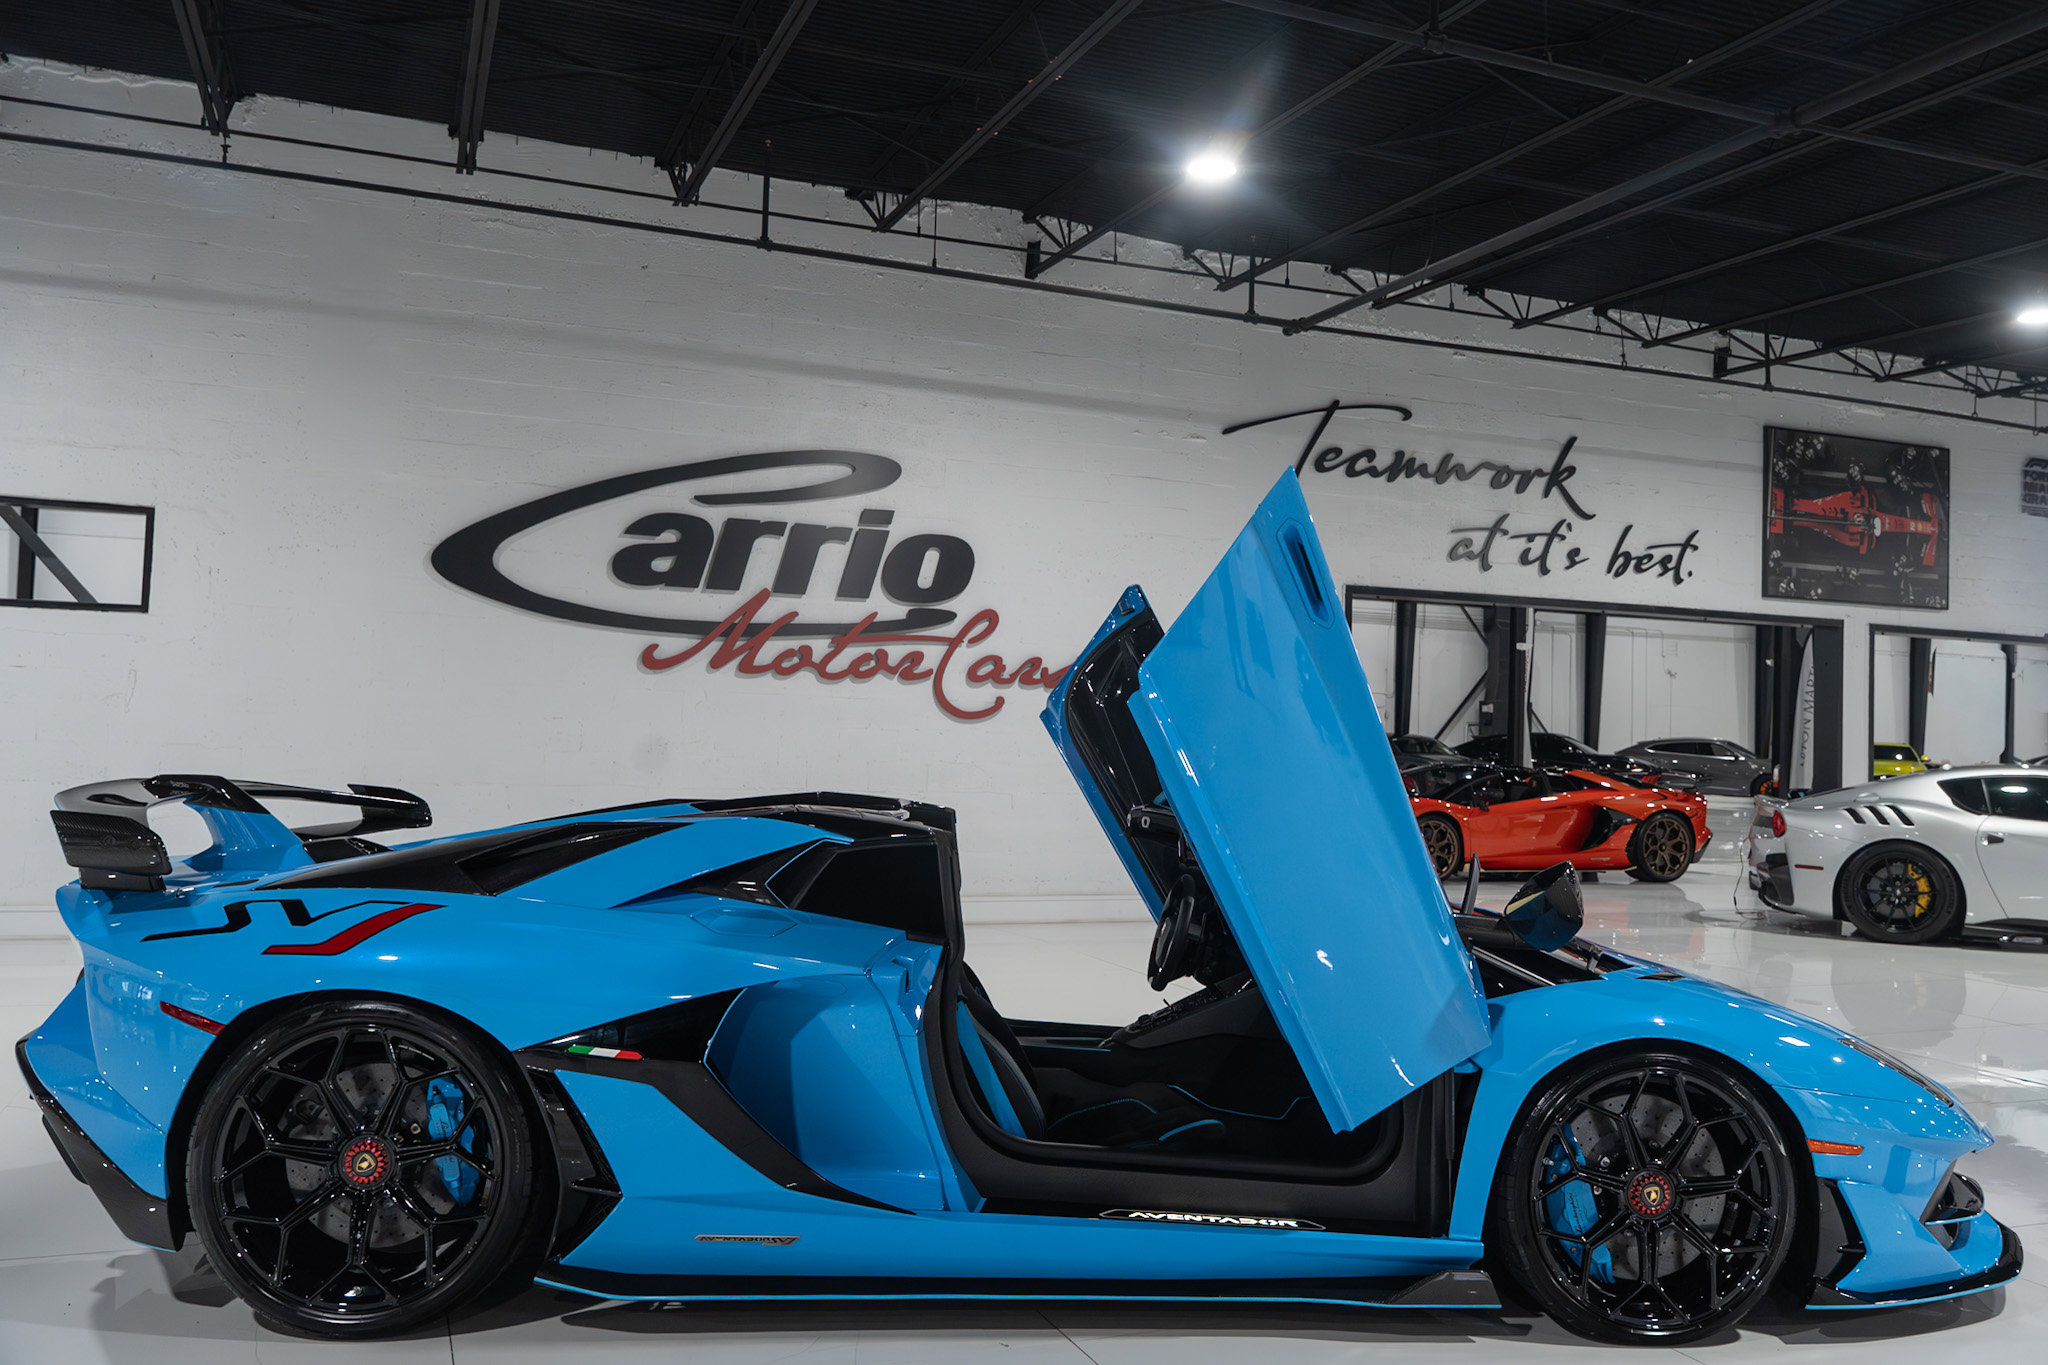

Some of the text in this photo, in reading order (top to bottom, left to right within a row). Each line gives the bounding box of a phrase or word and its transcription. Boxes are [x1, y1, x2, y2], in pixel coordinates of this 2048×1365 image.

[1222, 400, 1596, 520] Teamwork
[431, 450, 975, 637] Carrio
[1450, 513, 1699, 585] at it's best.
[1128, 1210, 1299, 1228] AVENTADOR
